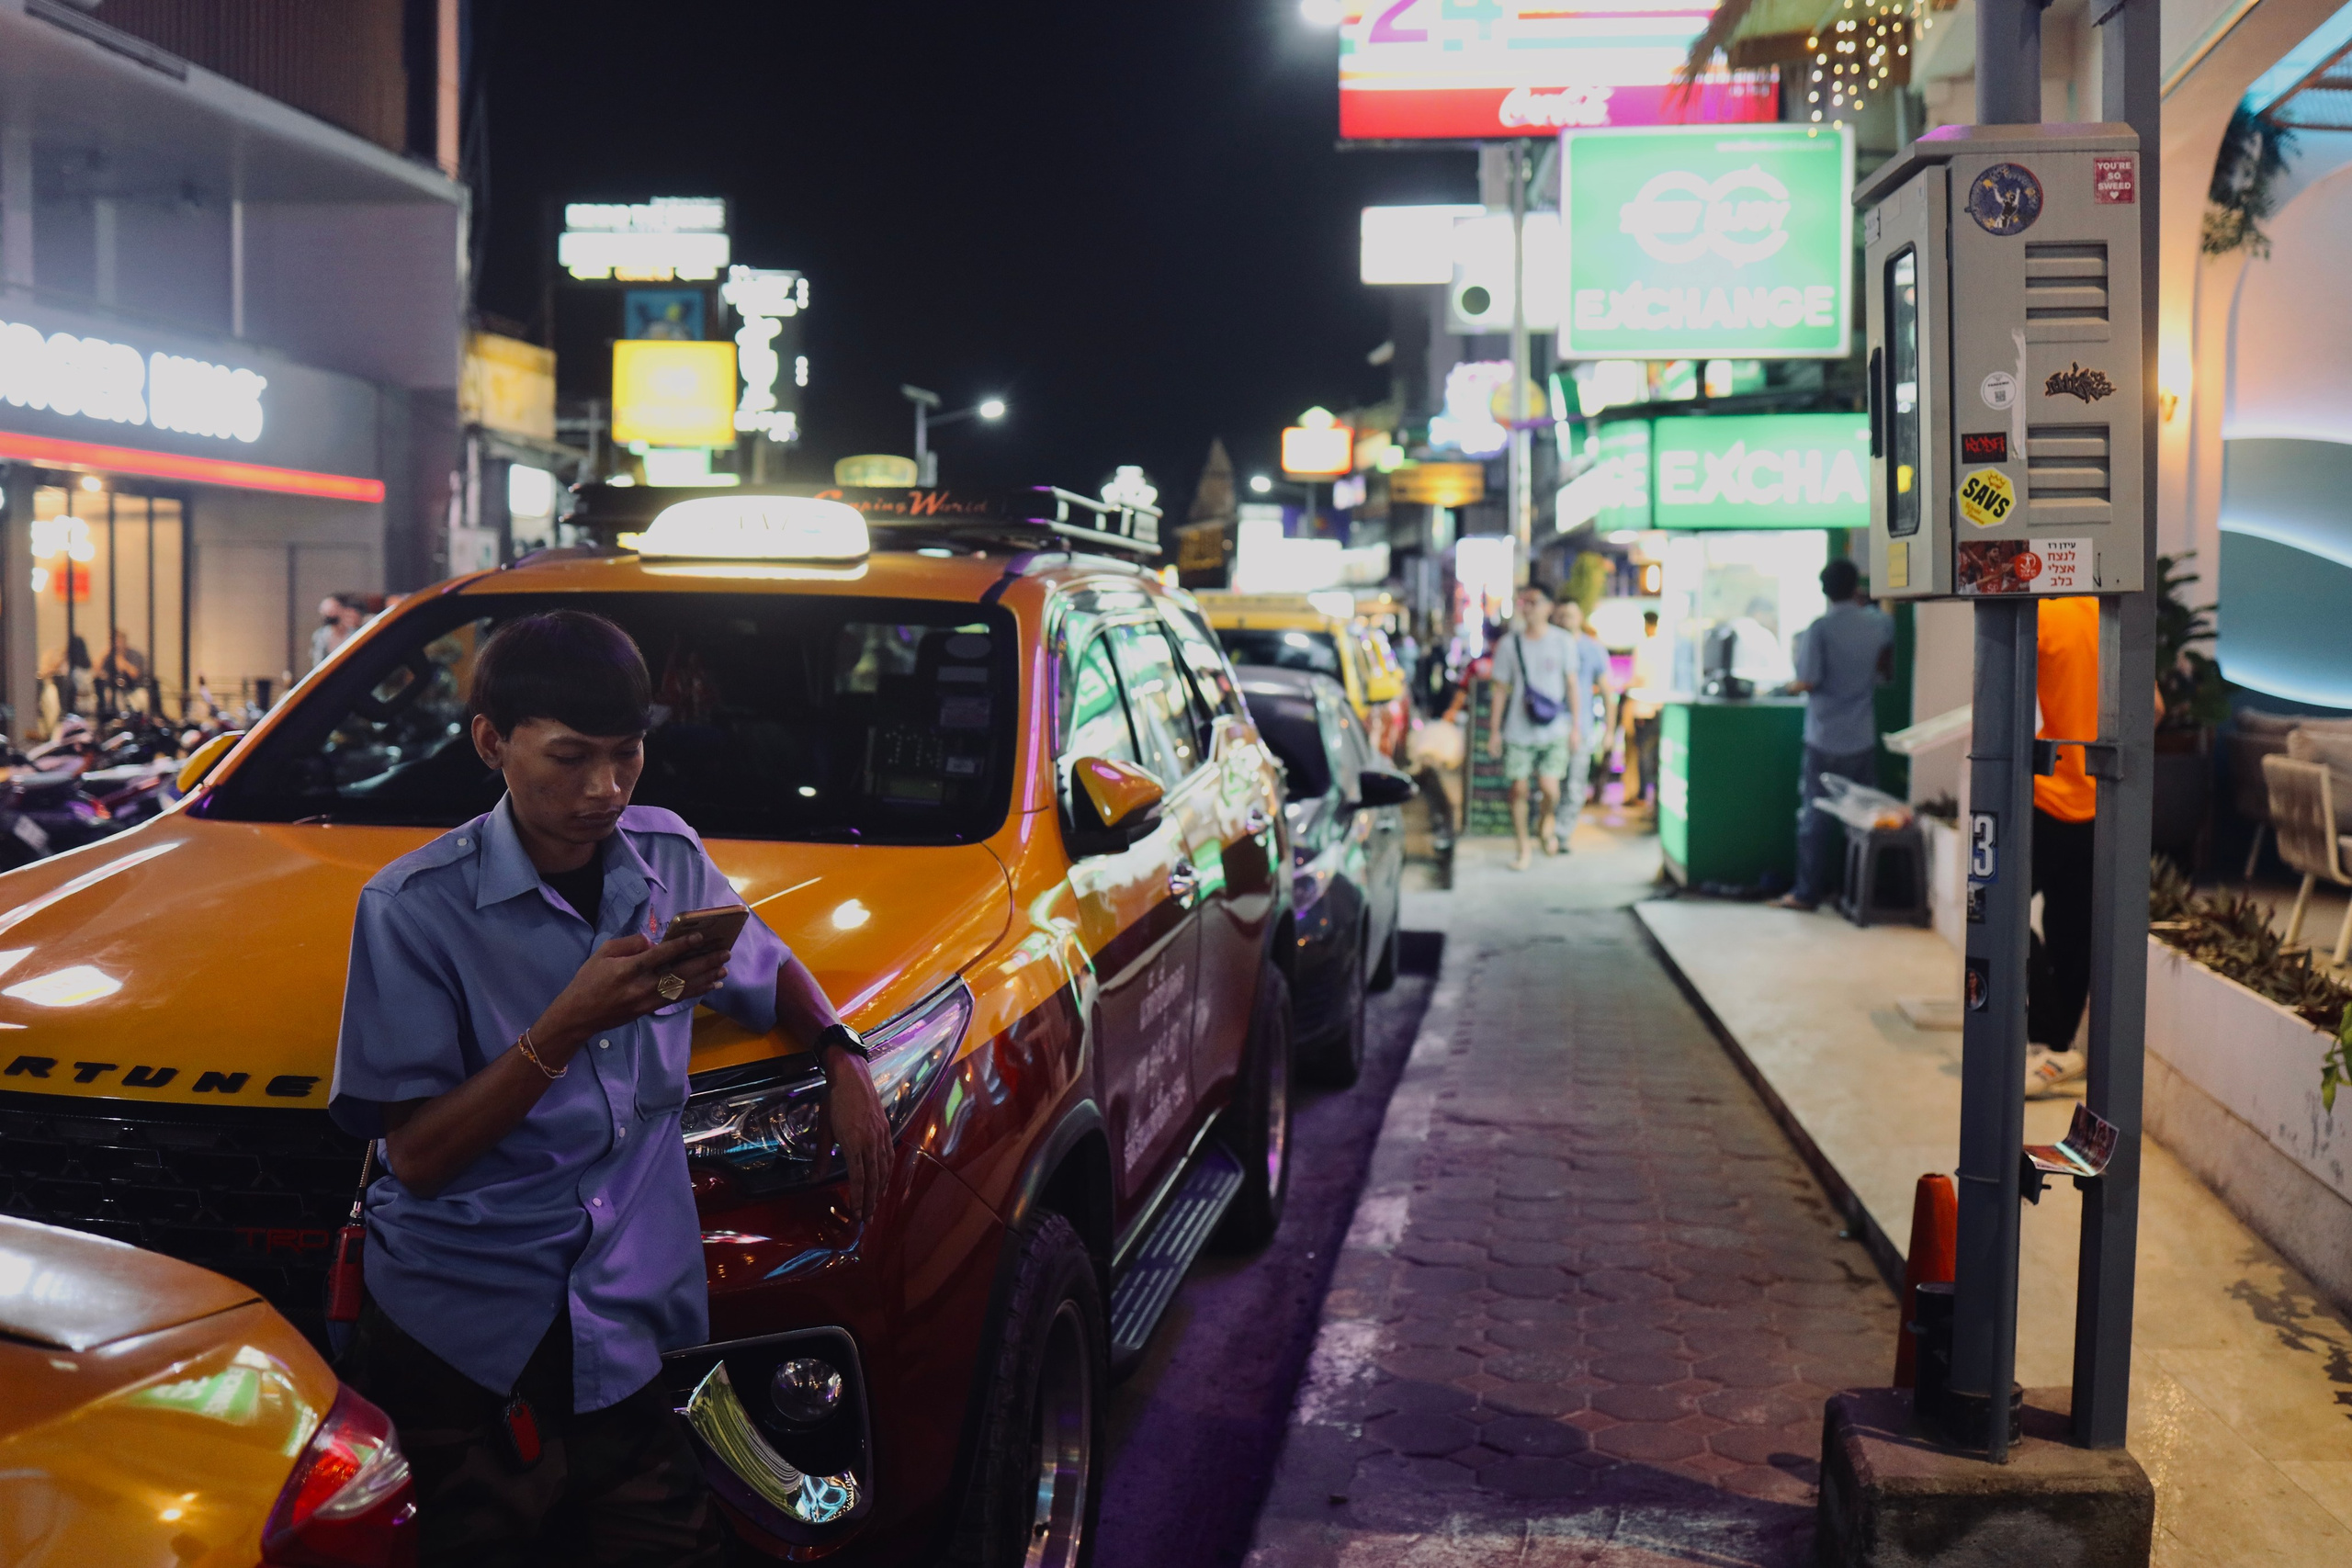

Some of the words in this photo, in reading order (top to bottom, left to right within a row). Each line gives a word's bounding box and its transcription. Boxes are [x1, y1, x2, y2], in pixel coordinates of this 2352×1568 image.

[2108, 172, 2121, 180] SO
[2098, 182, 2132, 190] SWEED
[1575, 280, 1836, 330] EXCHANGE
[1659, 440, 1868, 504] EXCHA
[1962, 478, 2010, 519] SAVS
[2047, 550, 2075, 561] לנצח
[2048, 563, 2075, 574] אצלי
[2050, 576, 2073, 587] בלב
[234, 1226, 330, 1255] TRD
